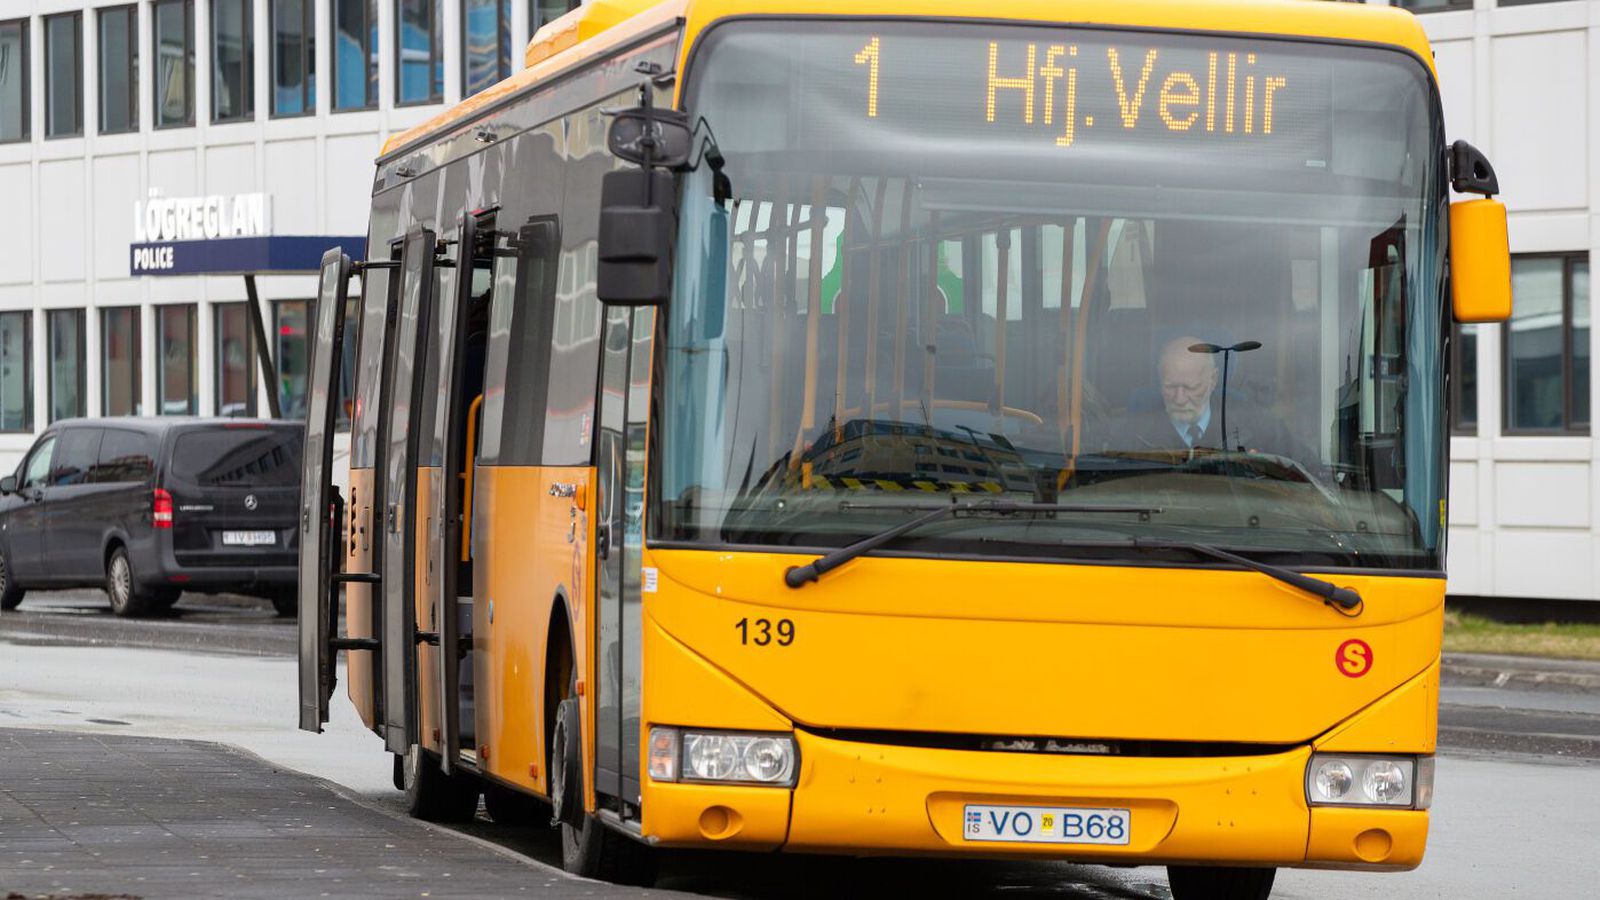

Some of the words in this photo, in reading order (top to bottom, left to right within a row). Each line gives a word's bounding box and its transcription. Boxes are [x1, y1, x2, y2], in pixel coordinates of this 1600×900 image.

[854, 36, 880, 117] 1
[134, 187, 265, 242] LÖGREGLAN
[134, 247, 174, 270] POLICE
[735, 617, 795, 646] 139
[1342, 643, 1366, 674] S
[967, 823, 980, 834] IS
[990, 811, 1033, 836] VO
[1063, 813, 1124, 839] B68
